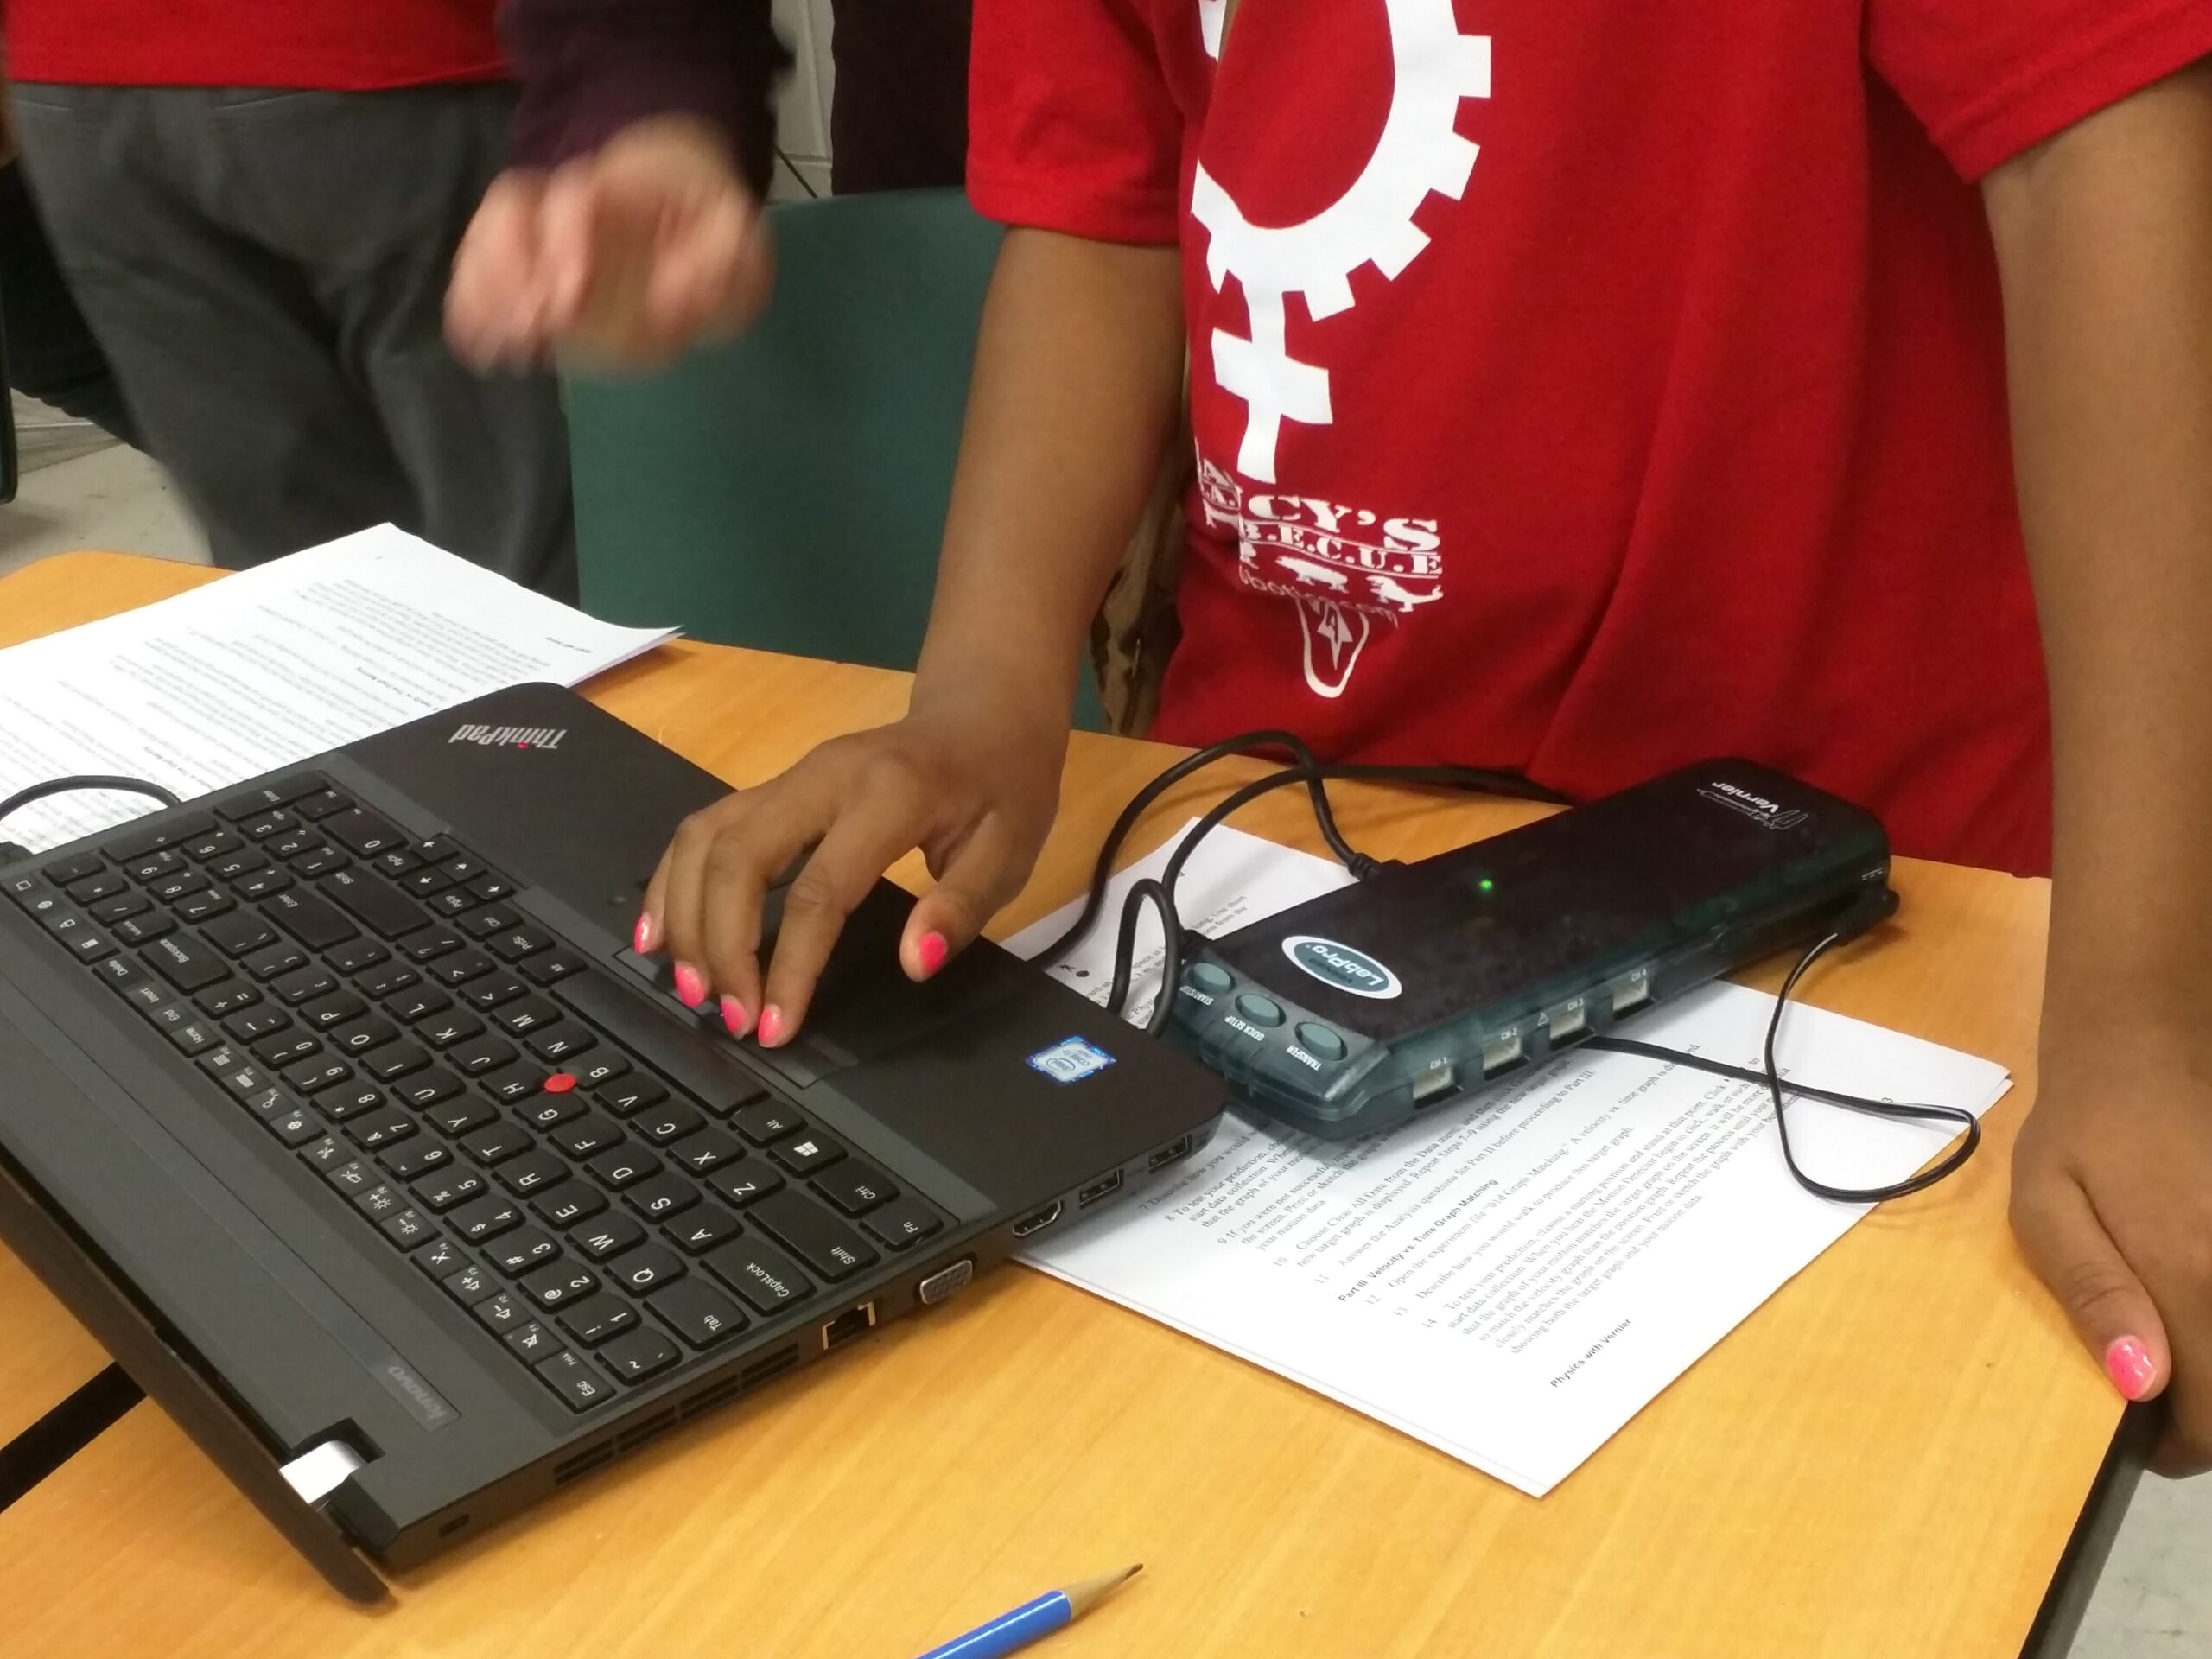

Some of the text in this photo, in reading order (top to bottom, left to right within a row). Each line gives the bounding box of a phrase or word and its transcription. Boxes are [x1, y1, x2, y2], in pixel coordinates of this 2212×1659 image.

[448, 724, 568, 749] ThinkPad
[1712, 782, 1779, 813] Vernier
[279, 894, 298, 907] Enter
[484, 917, 500, 926] Ctrl
[160, 938, 189, 963] Backspace
[1311, 944, 1384, 986] LabPro
[138, 988, 159, 1002] Insert
[162, 1009, 180, 1021] End
[409, 1003, 425, 1014] L
[512, 1014, 535, 1027] M
[186, 1027, 205, 1043] Home
[436, 1028, 457, 1039] K
[1224, 1015, 1265, 1042] QUICK SETUP
[350, 1034, 370, 1045] O
[548, 1041, 569, 1053] N
[1286, 1045, 1322, 1071] TRANSFER
[326, 1067, 343, 1076] 9
[386, 1064, 404, 1072] I
[589, 1067, 609, 1078] B
[415, 1089, 435, 1100] U
[503, 1083, 524, 1094] H
[358, 1094, 375, 1103] 8
[618, 1096, 638, 1107] V
[538, 1109, 558, 1120] G
[448, 1117, 467, 1132] Y
[656, 1123, 676, 1135] C
[767, 1120, 783, 1129] Alt
[482, 1146, 502, 1156] T
[575, 1141, 596, 1150] F
[1223, 1135, 1250, 1154] would
[424, 1151, 442, 1160] 6
[693, 1151, 716, 1165] X
[519, 1173, 541, 1185] R
[613, 1167, 633, 1179] D
[1339, 1242, 1372, 1267] Answer
[1467, 1154, 1487, 1166] Part
[1491, 1128, 1519, 1147] before
[1518, 1097, 1562, 1129] proceeding
[1564, 1078, 1585, 1090] Part
[1351, 1198, 1367, 1208] All
[1384, 1168, 1408, 1183] from
[1416, 1143, 1440, 1158] Data
[458, 1180, 477, 1190] 5
[733, 1182, 756, 1195] Z
[1204, 1182, 1226, 1197] your
[1341, 1217, 1365, 1235] graph
[1409, 1158, 1441, 1179] Repeat
[1438, 1141, 1463, 1158] Steps
[855, 1186, 876, 1199] Ctrl
[651, 1198, 671, 1210] S
[1208, 1196, 1229, 1208] data
[495, 1211, 511, 1220] 4
[556, 1205, 578, 1218] E
[904, 1222, 918, 1233] Fn
[690, 1228, 712, 1241] A
[1338, 1287, 1360, 1301] Part
[1368, 1254, 1404, 1278] Velocity
[1413, 1227, 1436, 1242] Time
[1434, 1208, 1461, 1226] Graph
[1459, 1179, 1498, 1207] Matching
[532, 1243, 550, 1254] 3
[588, 1234, 614, 1250] W
[831, 1247, 855, 1264] Shift
[570, 1276, 590, 1287] 2
[632, 1268, 654, 1282] Q
[747, 1262, 789, 1297] CapsLock
[610, 1313, 627, 1322] 1
[704, 1315, 722, 1332] Tab
[1550, 1319, 1631, 1388] Physics with Vernier
[388, 1365, 447, 1421] lenovo
[576, 1381, 595, 1396] Esc
